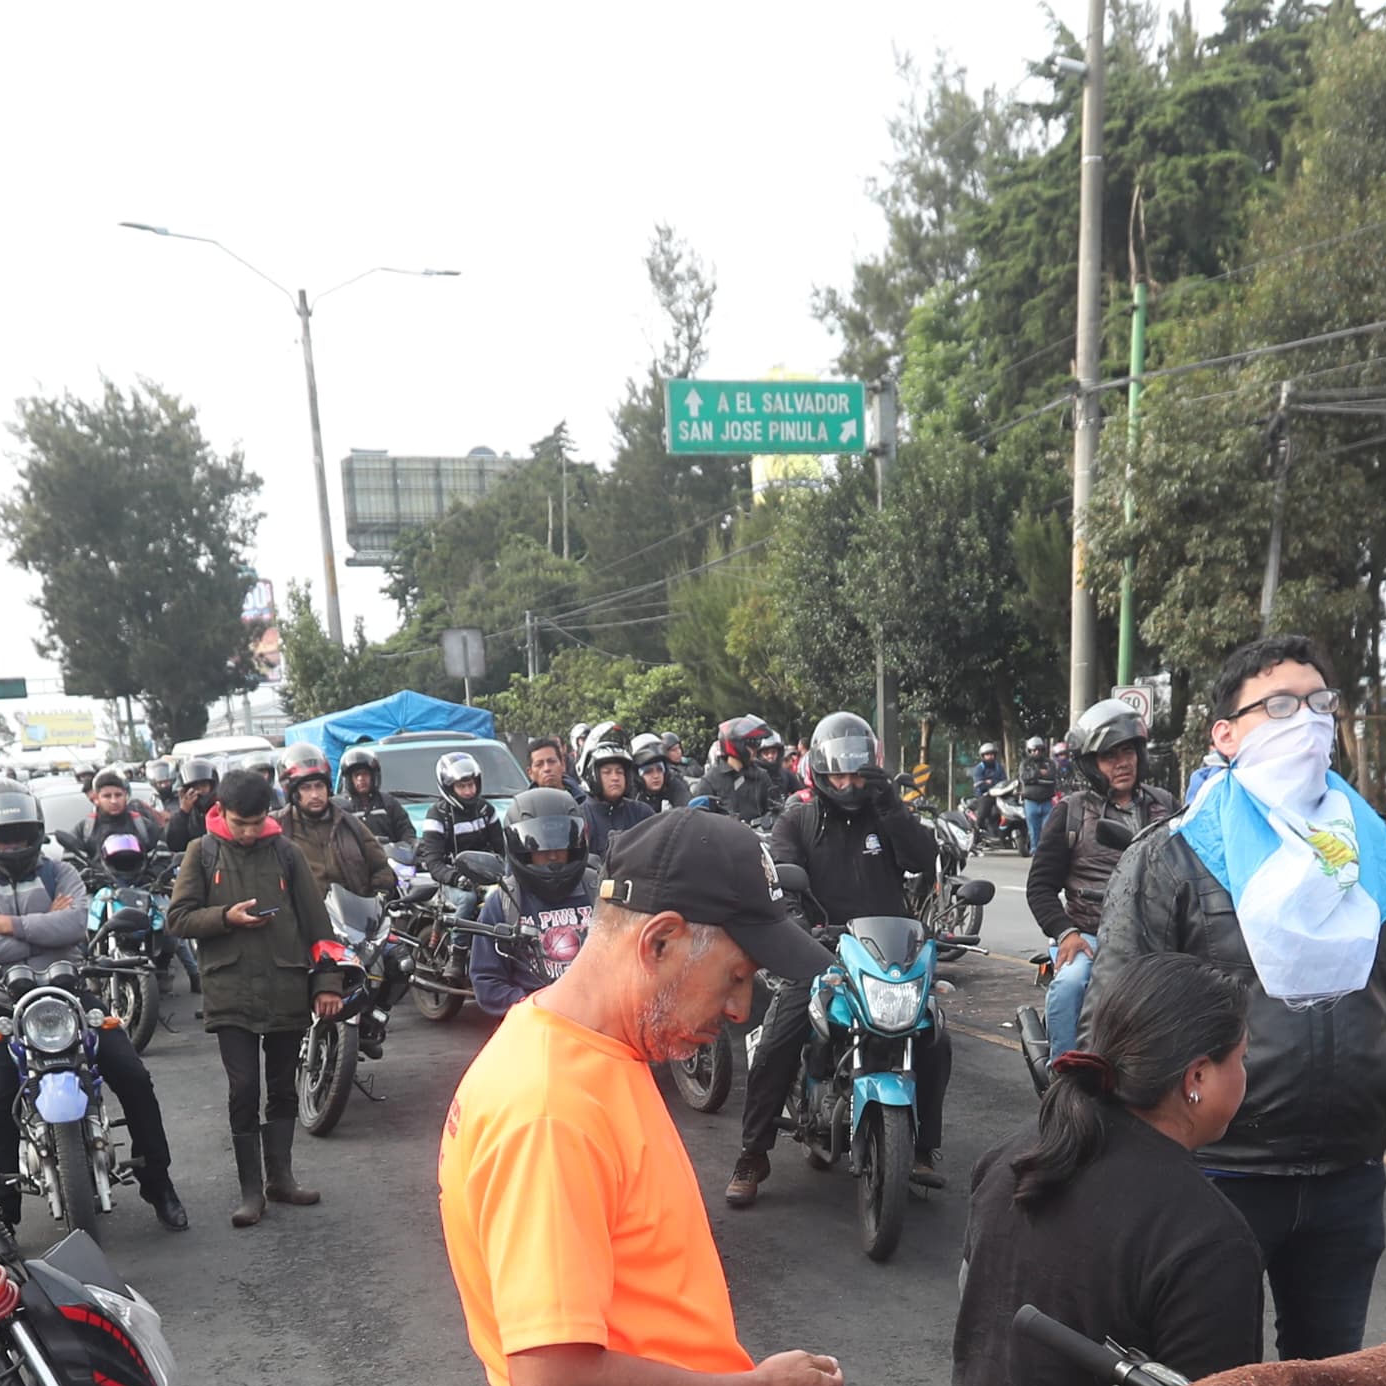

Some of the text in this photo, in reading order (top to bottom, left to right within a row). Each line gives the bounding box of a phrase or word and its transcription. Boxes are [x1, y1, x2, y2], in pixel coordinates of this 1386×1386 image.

[717, 392, 850, 415] A EL SALVADOR
[678, 420, 829, 442] SAN JOSE PINULA
[538, 908, 579, 930] PIUS
